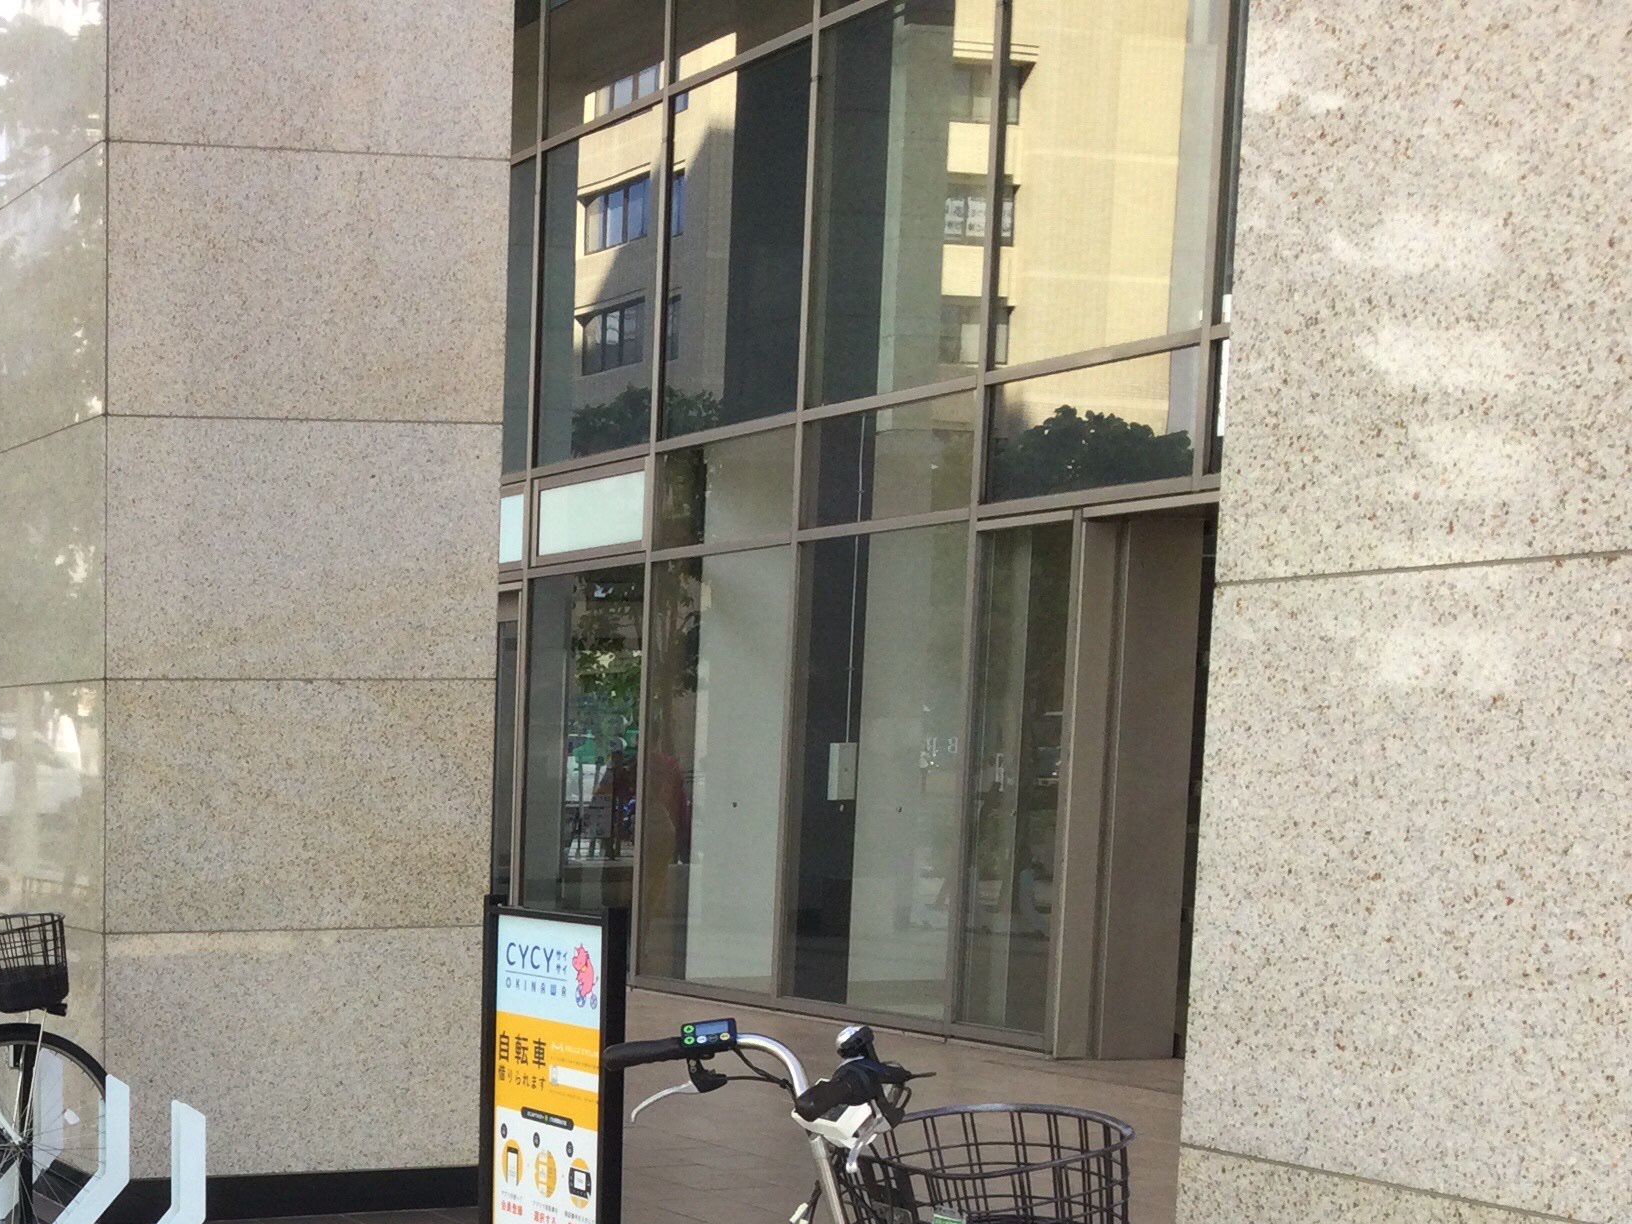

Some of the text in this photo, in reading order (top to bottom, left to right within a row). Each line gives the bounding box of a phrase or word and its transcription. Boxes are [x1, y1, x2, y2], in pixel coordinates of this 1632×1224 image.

[506, 942, 554, 973] CYCY
[505, 976, 567, 998] OKINAWA
[499, 1030, 546, 1069] 自転車
